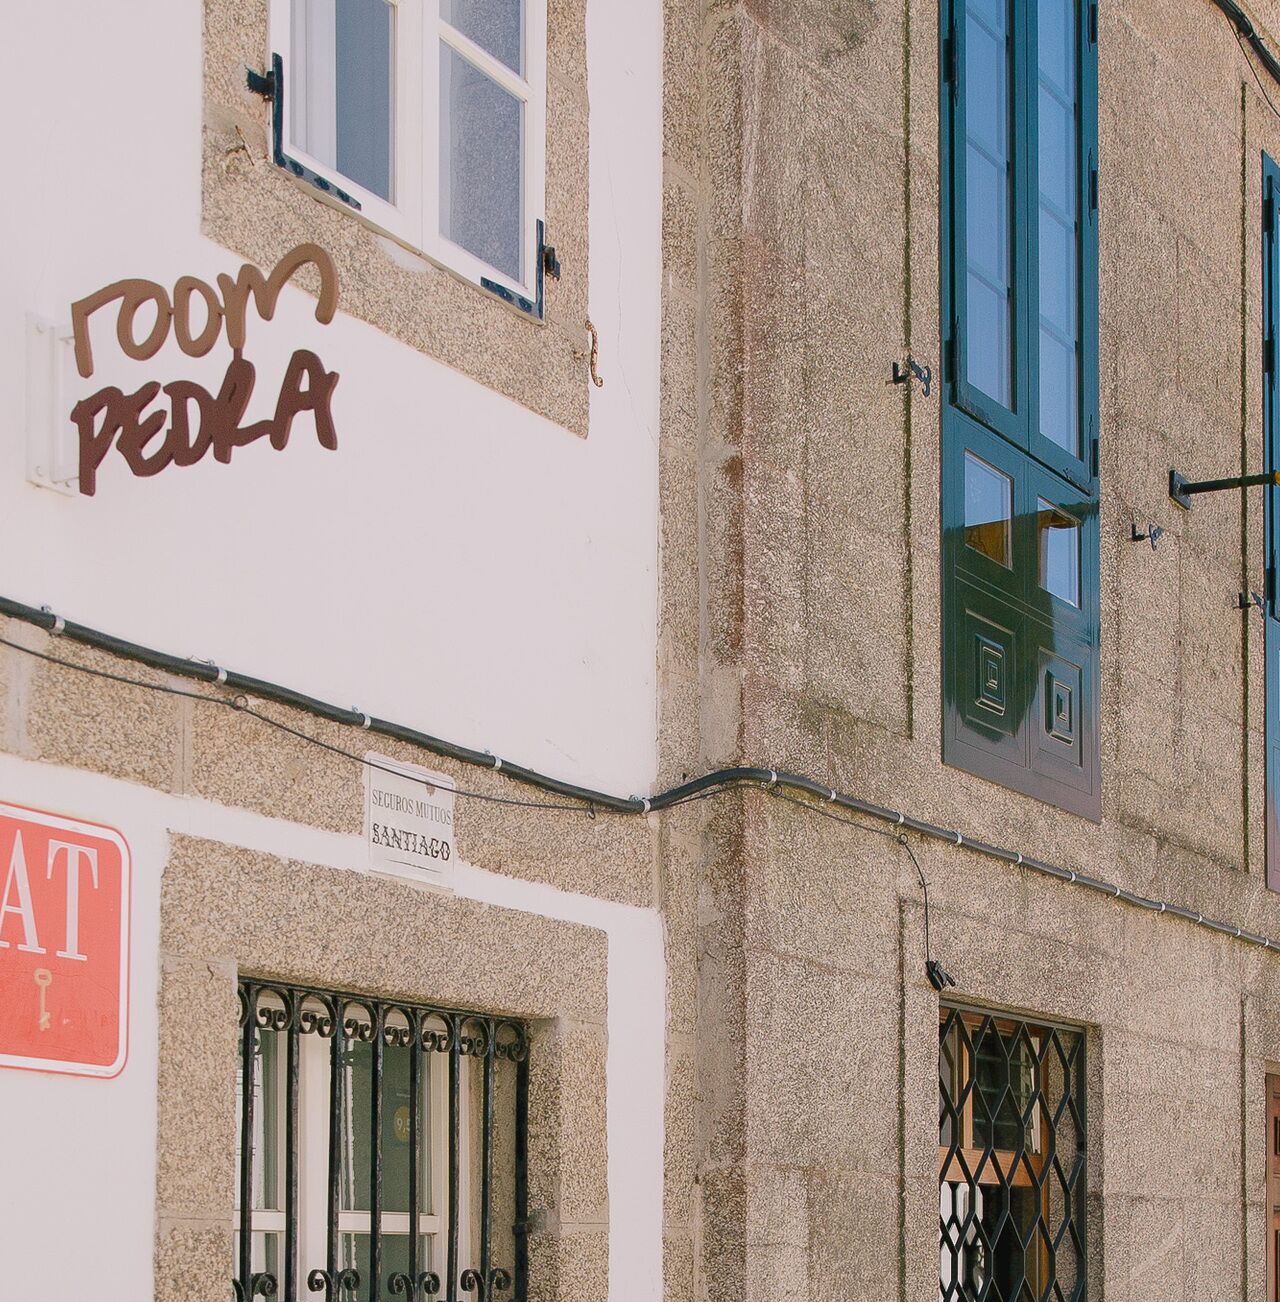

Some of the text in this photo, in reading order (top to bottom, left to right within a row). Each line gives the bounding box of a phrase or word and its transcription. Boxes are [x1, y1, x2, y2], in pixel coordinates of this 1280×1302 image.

[71, 242, 339, 379] room
[70, 349, 340, 497] PEDRA
[372, 788, 452, 826] SEGUROS MUTUOS
[372, 822, 451, 862] SANTIAGO
